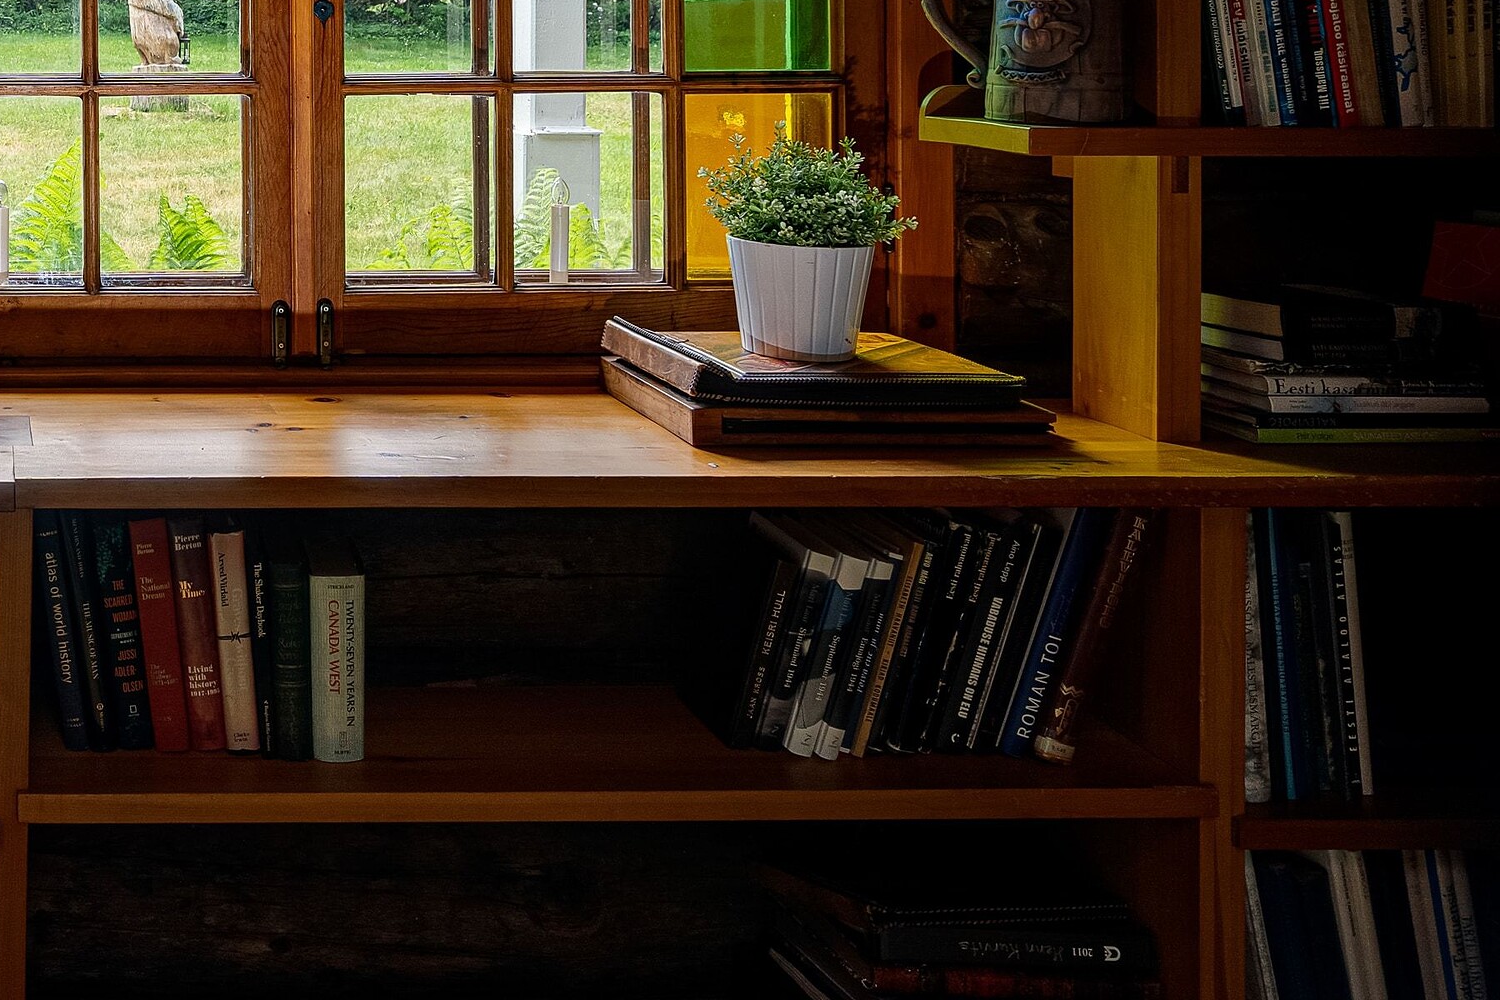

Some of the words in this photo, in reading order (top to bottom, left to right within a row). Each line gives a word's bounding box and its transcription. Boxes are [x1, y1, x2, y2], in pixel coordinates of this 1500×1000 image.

[1269, 0, 1282, 25] BALTI
[1234, 19, 1253, 82] UUDISHIMU
[1274, 28, 1287, 55] MERE
[1312, 49, 1328, 92] Madisson
[1335, 41, 1354, 113] käsiraamat
[1317, 94, 1329, 110] Tiit
[1275, 378, 1315, 393] Eesti
[173, 534, 200, 543] Pierre
[174, 541, 201, 550] Berton
[1008, 540, 1020, 560] Aino
[45, 552, 59, 582] atlas
[217, 551, 227, 577] Arved
[253, 563, 262, 577] The
[998, 560, 1013, 582] Lepp
[1332, 546, 1345, 600] ATLAS
[49, 585, 62, 599] of
[111, 580, 124, 590] THE
[140, 581, 169, 592] National
[142, 591, 164, 599] Dream
[179, 580, 192, 590] My
[218, 576, 230, 606] Viirlaid
[254, 578, 263, 604] Shaker
[945, 578, 958, 599] Eesti
[968, 581, 981, 603] Eesti
[81, 602, 91, 619] THE
[103, 594, 132, 607] SCARRED
[52, 603, 67, 636] world
[255, 605, 265, 637] Daybook
[328, 600, 340, 654] CANADA
[761, 619, 778, 655] KEISRI
[771, 588, 786, 618] HULL
[979, 595, 1003, 645] VABADUSE
[84, 619, 95, 647] MUSIC
[345, 599, 355, 676] TWENTY-SEVEN
[88, 647, 96, 659] OF
[117, 648, 137, 660] JUSSI
[819, 634, 841, 680] September
[1338, 616, 1352, 684] AJALOO
[55, 640, 74, 684] history
[89, 659, 99, 679] MAN
[187, 664, 213, 674] Living
[966, 644, 988, 686] HINNAKS
[122, 680, 143, 692] OLSEN
[188, 673, 206, 681] with
[188, 679, 217, 689] history
[328, 660, 340, 694] WEST
[782, 668, 795, 688] 1944
[845, 672, 858, 692] 1944
[1016, 670, 1050, 739] ROMAN
[1040, 633, 1062, 665] TOI
[346, 680, 355, 712] YEARS
[745, 696, 757, 718] JAAN
[752, 665, 765, 694] KROSS
[814, 681, 827, 701] 1944
[962, 686, 975, 701] ON
[956, 700, 971, 718] ELU
[346, 716, 355, 726] IN
[1345, 699, 1357, 751] EESTI
[1072, 947, 1091, 956] 2011
